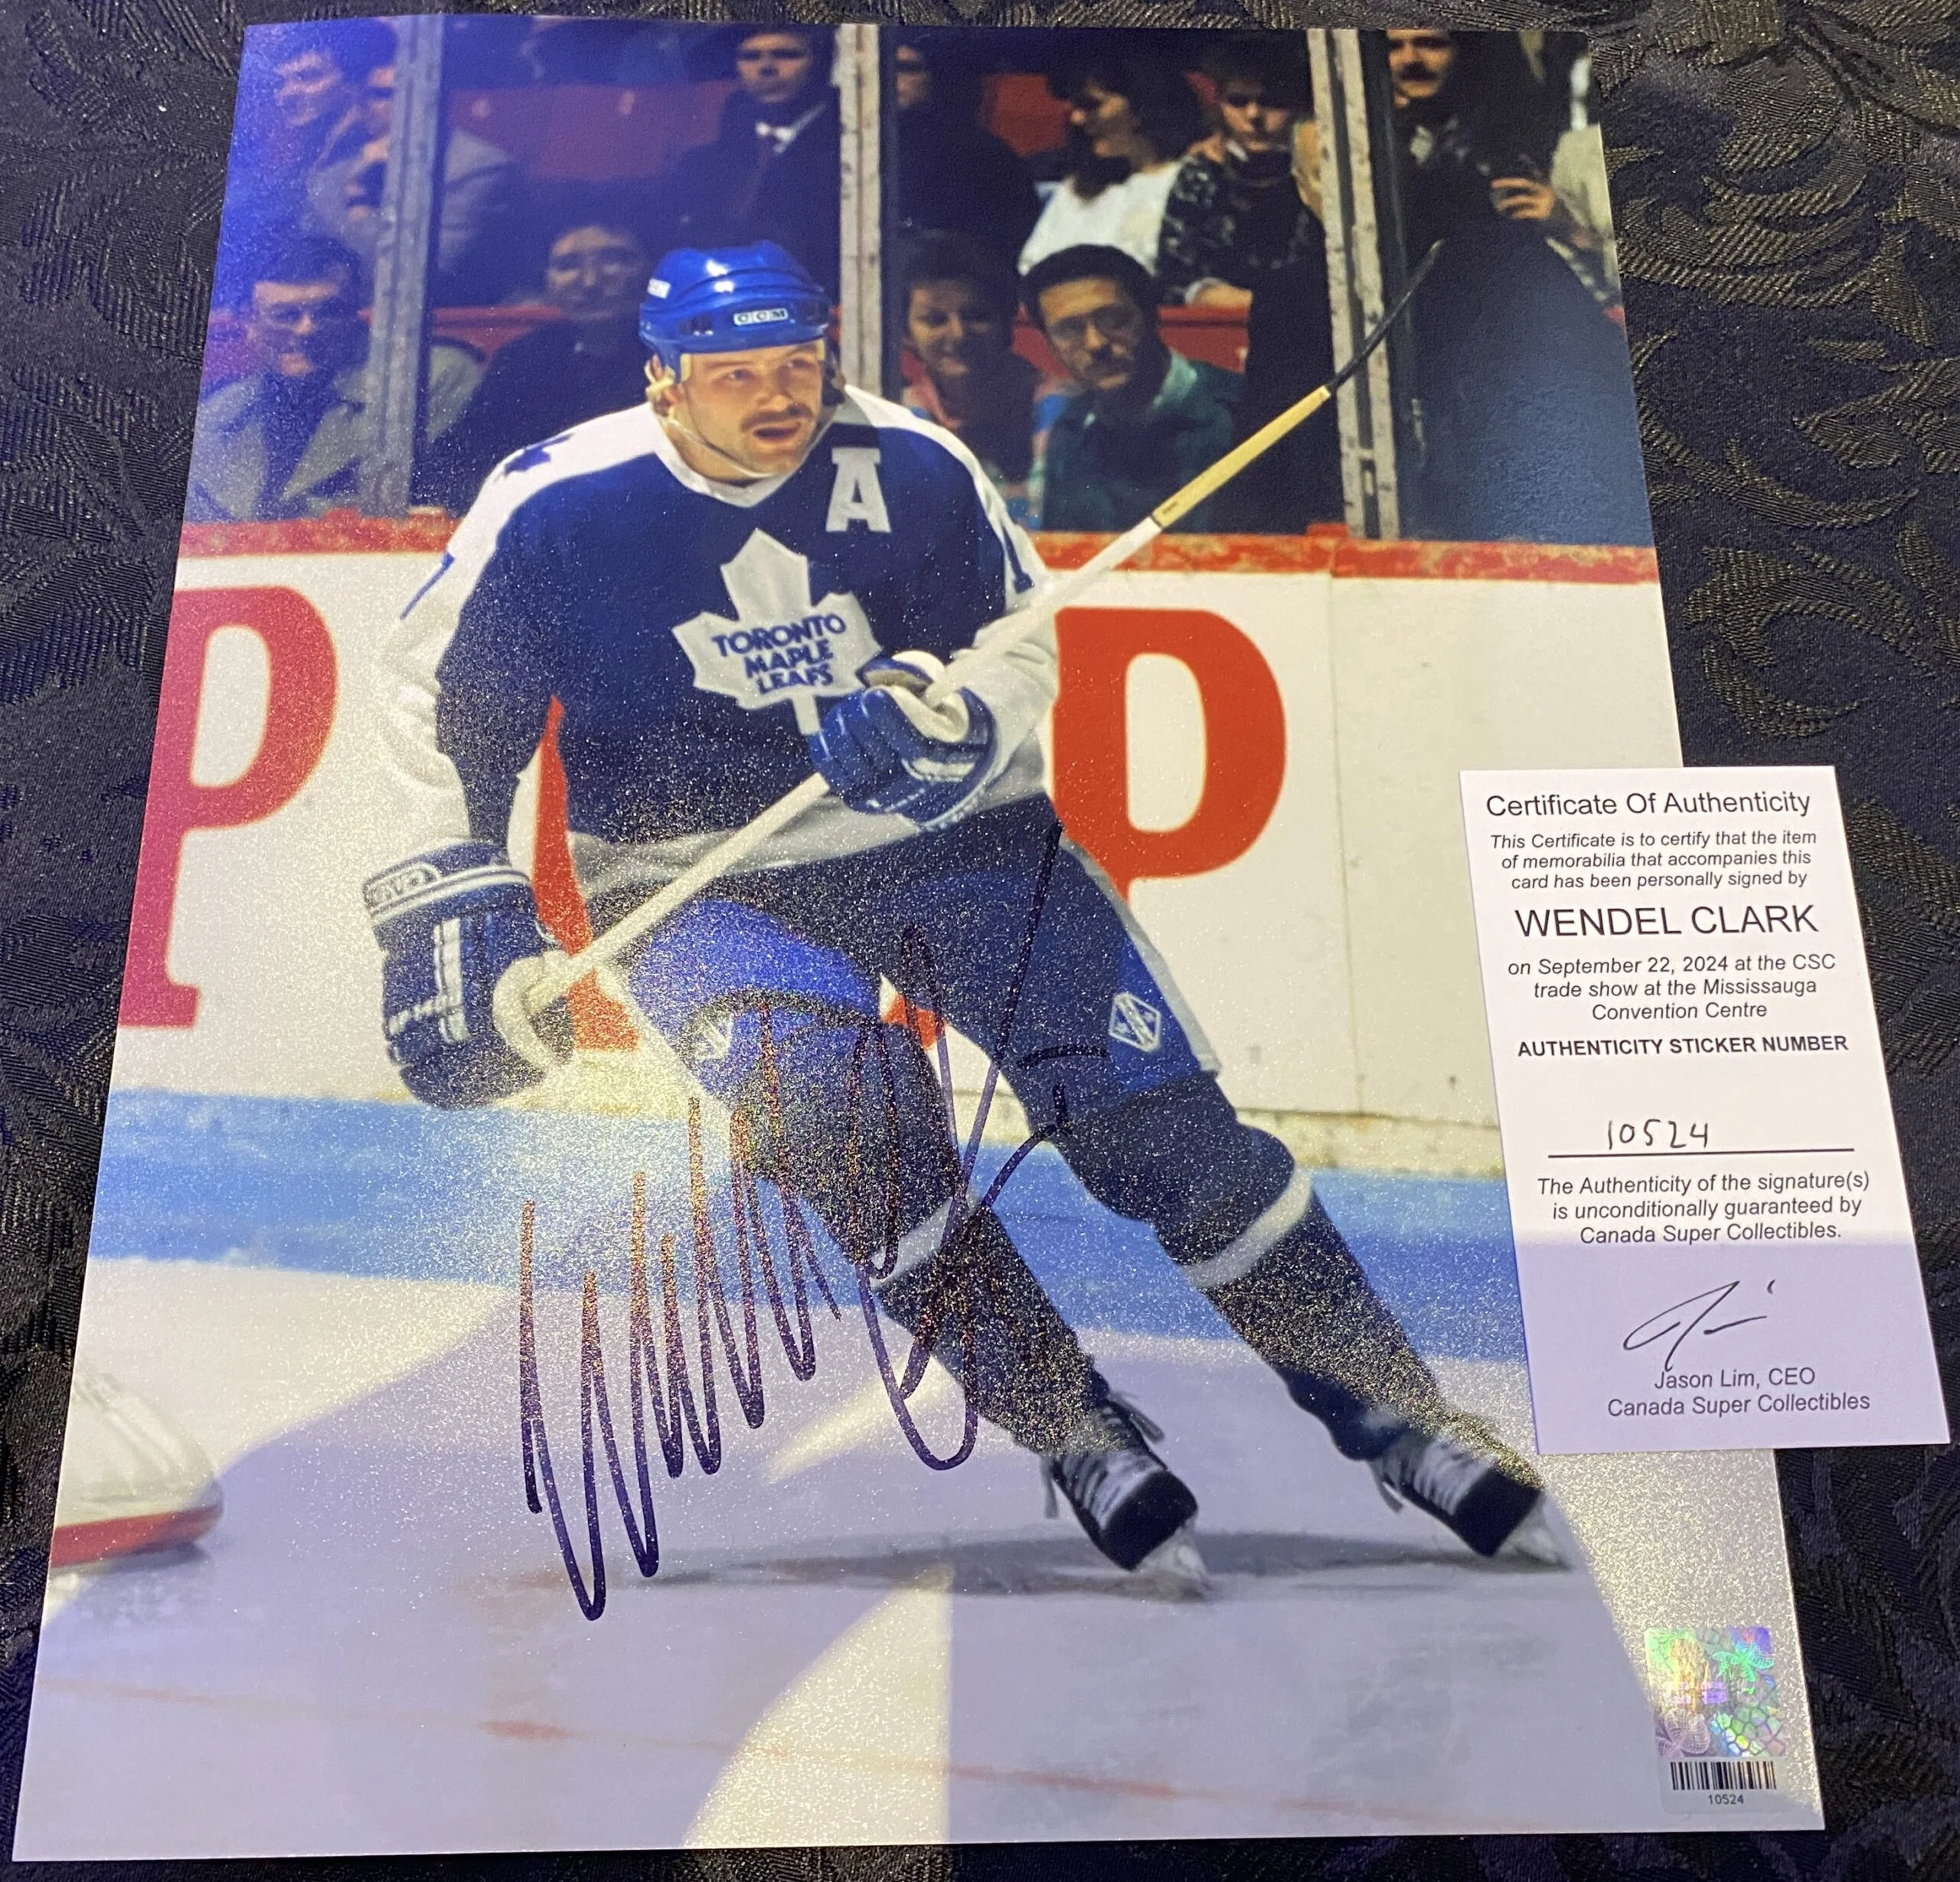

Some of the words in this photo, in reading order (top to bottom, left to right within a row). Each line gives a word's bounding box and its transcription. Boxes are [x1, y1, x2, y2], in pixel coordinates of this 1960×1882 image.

[735, 309, 787, 324] CCM
[825, 447, 892, 533] A
[710, 613, 847, 658] TORONTO
[743, 639, 834, 678] MAPLE
[756, 663, 834, 695] LEAFS
[1486, 793, 1618, 817] Certificate
[1625, 792, 1657, 815] Of
[1663, 790, 1811, 818] Authenticity
[1490, 834, 1526, 849] This
[1531, 832, 1616, 848] Certificate
[1621, 832, 1635, 847] is
[1639, 832, 1656, 847] to
[1660, 831, 1711, 849] certify
[1715, 830, 1747, 845] that
[1751, 829, 1777, 845] the
[1782, 829, 1817, 845] item
[1501, 854, 1520, 870] of
[1522, 852, 1625, 869] memorabilia
[1630, 851, 1663, 867] that
[1668, 850, 1778, 869] accompanies
[1782, 849, 1811, 864] this
[1511, 874, 1549, 890] card
[1553, 874, 1585, 889] has
[1589, 873, 1632, 888] been
[1636, 871, 1723, 891] personally
[1727, 870, 1783, 889] signed
[1788, 870, 1808, 888] by
[1514, 907, 1683, 938] WENDEL
[1690, 904, 1820, 935] CLARK
[1508, 962, 1531, 975] on
[1537, 956, 1643, 979] September
[1647, 956, 1675, 975] 22,
[1682, 955, 1729, 972] 2024
[1734, 955, 1753, 972] at
[1757, 954, 1786, 971] the
[1792, 952, 1836, 970] CSC
[1534, 981, 1583, 998] trade
[1588, 980, 1638, 998] show
[1644, 979, 1662, 997] at
[1667, 979, 1697, 996] the
[1703, 977, 1817, 998] Mississauga
[1592, 1002, 1698, 1021] Convention
[1705, 1001, 1768, 1018] Centre
[1517, 1038, 1664, 1057] AUTHENTICITY
[1668, 1037, 1758, 1054] STICKER
[1761, 1034, 1850, 1053] NUMBER
[1607, 1118, 1709, 1151] 10524
[1537, 1178, 1574, 1195] The
[1578, 1175, 1692, 1197] Authenticity
[1697, 1174, 1717, 1192] of
[1721, 1173, 1752, 1191] the
[1757, 1170, 1870, 1194] signature(s)
[1553, 1202, 1568, 1220] is
[1575, 1198, 1719, 1221] unconditionally
[1723, 1195, 1834, 1220] guaranteed
[1839, 1195, 1862, 1217] by
[1579, 1225, 1655, 1244] Canada
[1663, 1224, 1722, 1246] Super
[1726, 1220, 1841, 1240] Collectibles.
[1654, 1371, 1713, 1390] Jason
[1720, 1368, 1760, 1390] Lim,
[1768, 1367, 1815, 1387] CEO
[1607, 1397, 1684, 1417] Canada
[1692, 1396, 1752, 1419] Super
[1757, 1391, 1870, 1413] Collectibles
[1708, 1795, 1744, 1805] 10524
